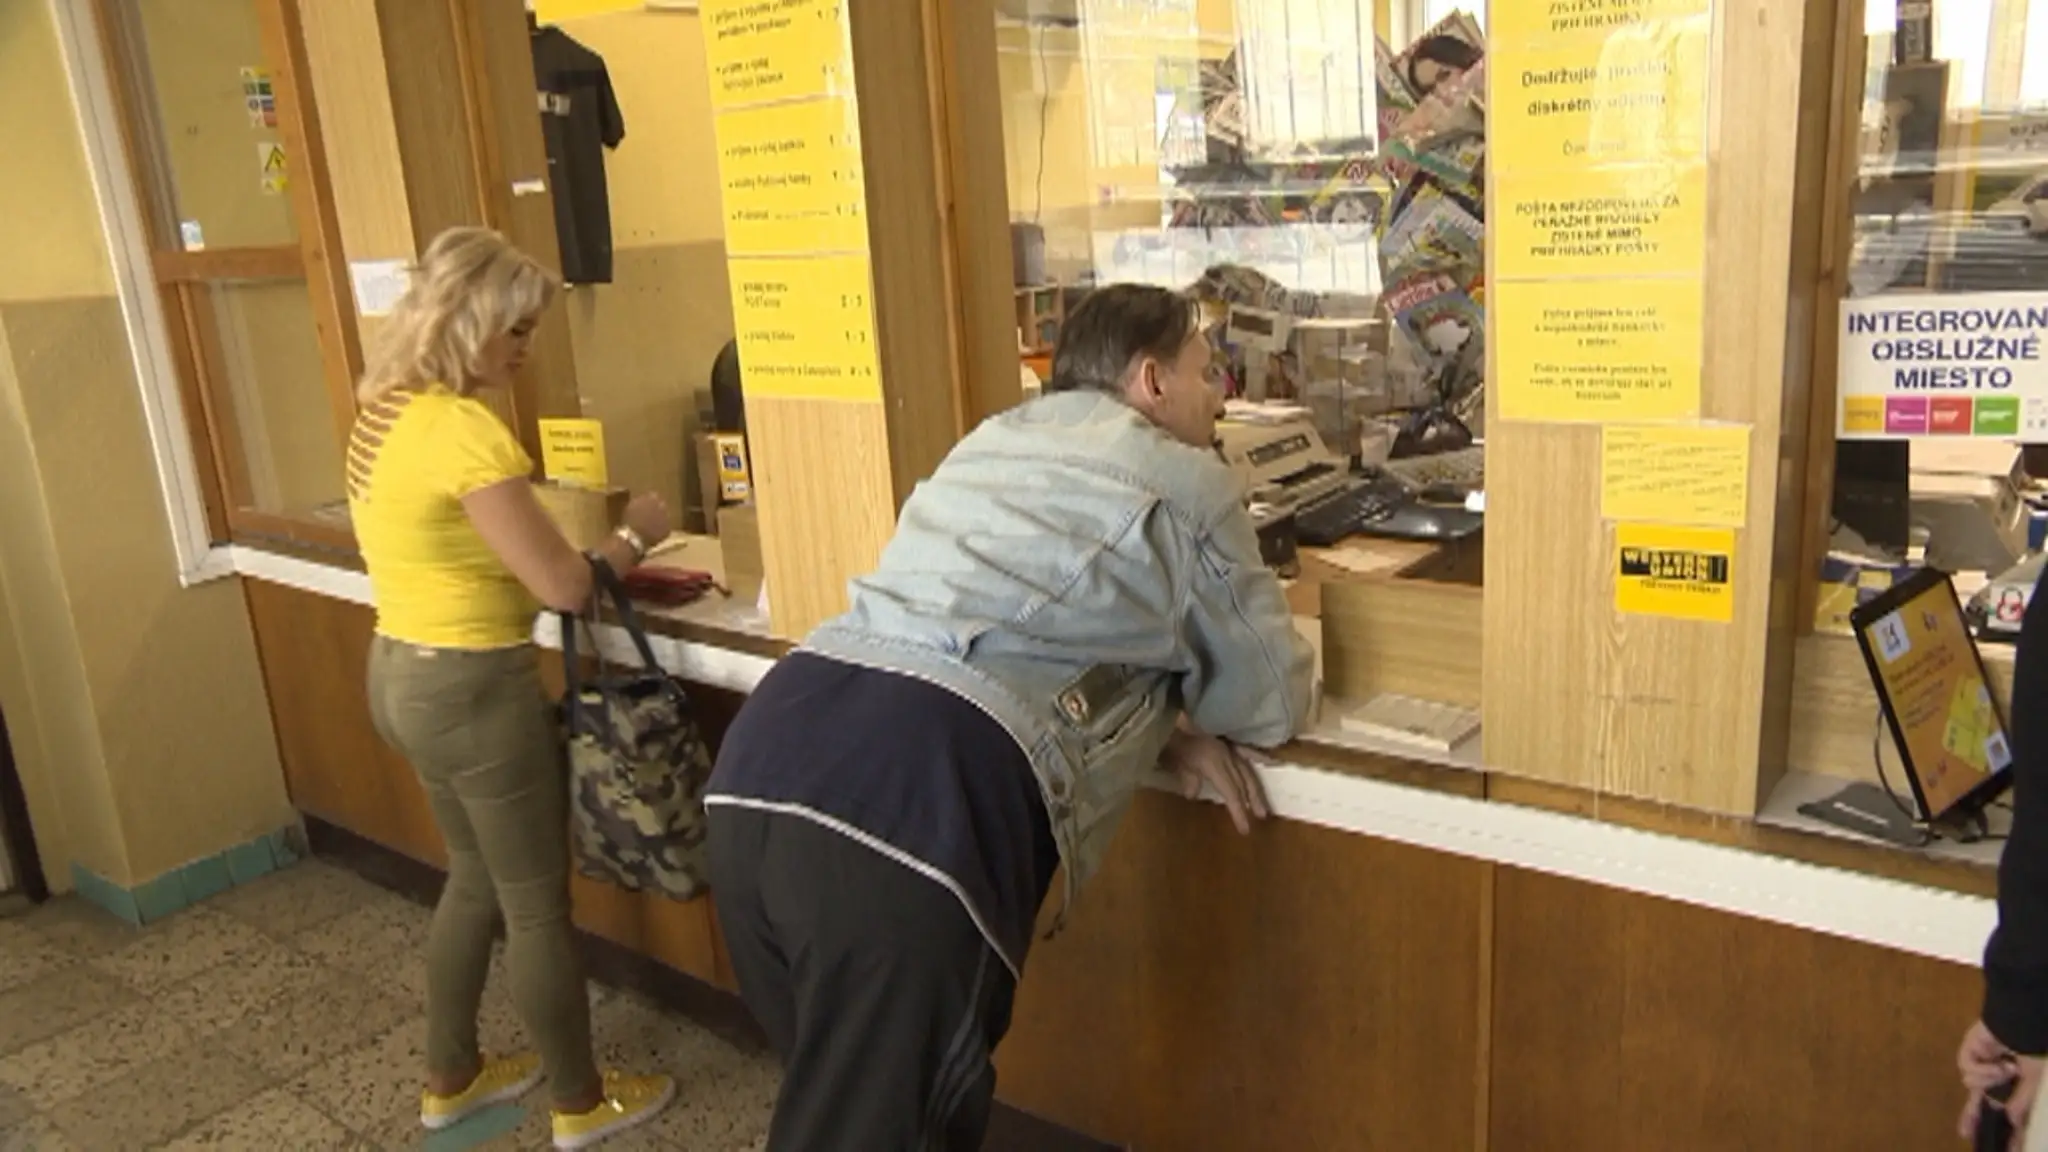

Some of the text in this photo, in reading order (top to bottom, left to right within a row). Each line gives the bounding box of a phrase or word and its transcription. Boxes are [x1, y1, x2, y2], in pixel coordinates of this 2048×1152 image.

[1515, 198, 1557, 217] POŠTA
[1662, 194, 1682, 210] ZA
[1606, 226, 1643, 240] MIMO
[1615, 241, 1661, 256] POŠTY
[1872, 332, 2041, 361] OBSLUŽNÉ
[1895, 366, 2013, 389] MIESTO
[1623, 549, 1708, 569] WESTERN
